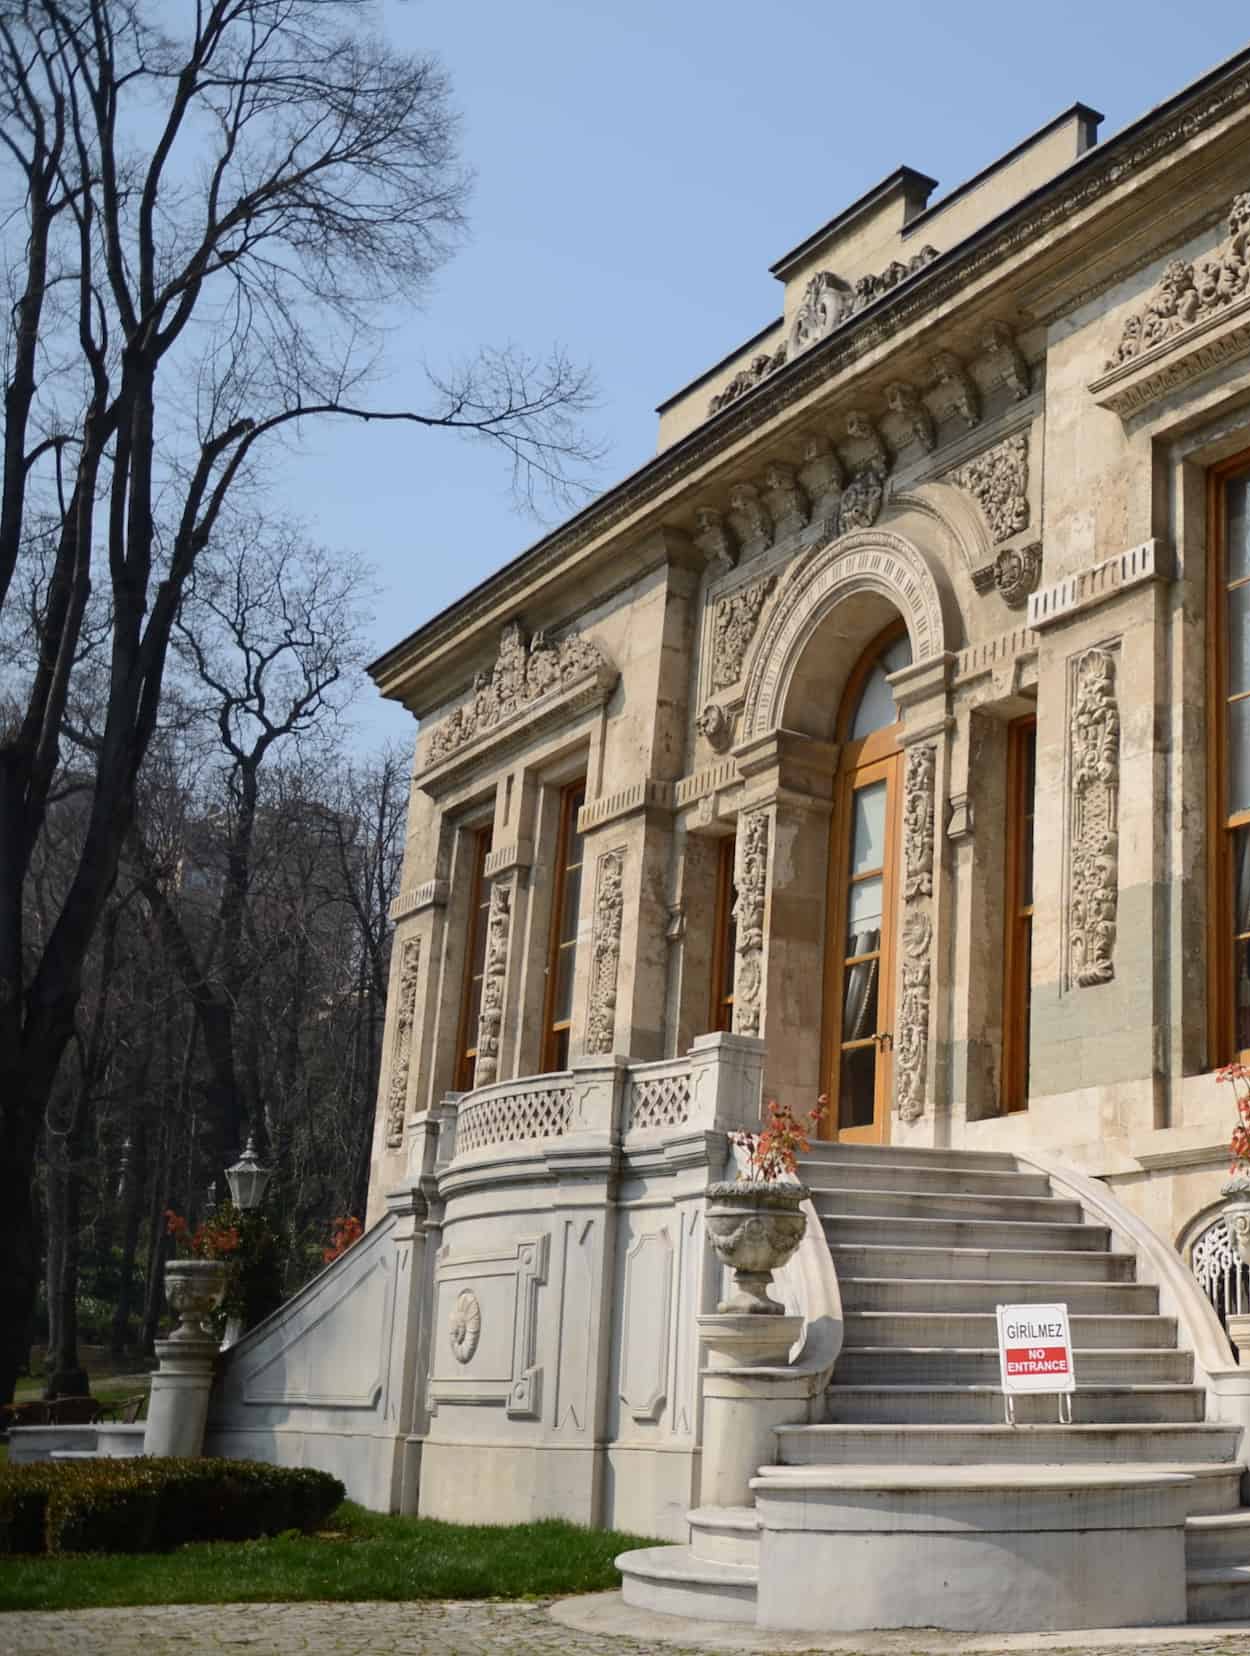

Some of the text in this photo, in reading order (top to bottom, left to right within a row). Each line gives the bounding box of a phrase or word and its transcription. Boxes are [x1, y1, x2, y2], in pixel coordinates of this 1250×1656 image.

[1007, 1321, 1063, 1339] GİRİLMEZ
[1028, 1349, 1045, 1360] NO
[1008, 1360, 1067, 1372] ENTRANCE
